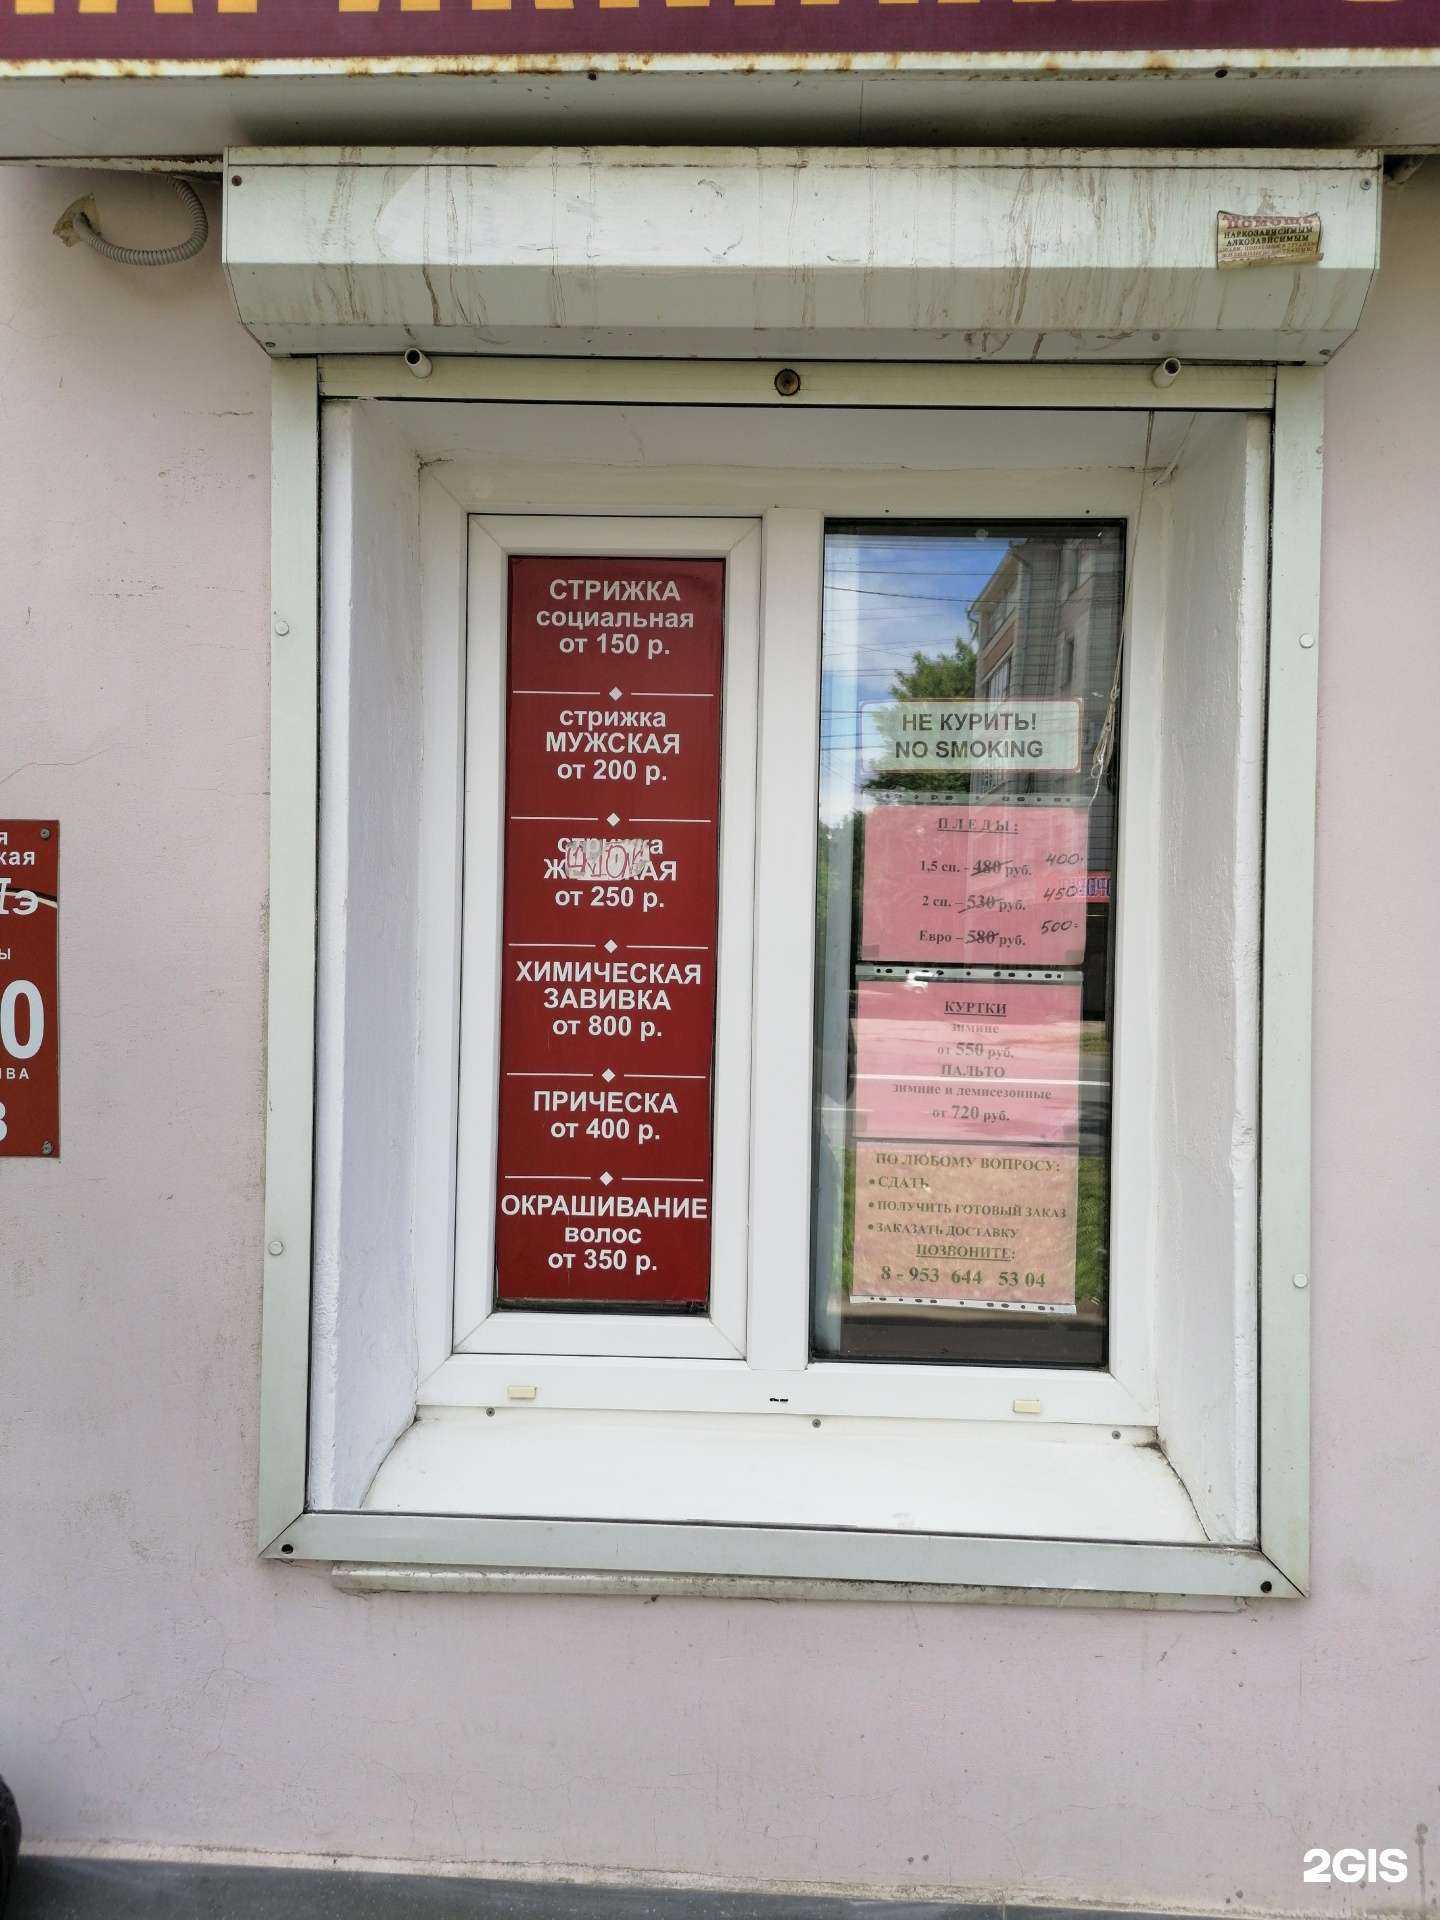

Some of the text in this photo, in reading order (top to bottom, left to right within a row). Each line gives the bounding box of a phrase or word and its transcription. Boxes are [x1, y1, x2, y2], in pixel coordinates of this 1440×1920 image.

[549, 578, 681, 601] СТРИЖКА
[536, 610, 694, 630] социальная
[559, 633, 670, 659] от 150 р.
[559, 709, 666, 731] стрижка
[902, 712, 1037, 732] НЕ КУРИТЬ!
[546, 731, 680, 755] МУЖСКАЯ
[895, 740, 1044, 759] NO SMOKING
[557, 759, 667, 785] от 200 р.
[1005, 863, 1032, 878] руб.
[555, 886, 665, 912] от 250 р.
[922, 896, 929, 906] 2
[999, 900, 1026, 912] руб.
[919, 929, 952, 946] Евро
[999, 934, 1026, 947] руб.
[515, 961, 701, 985] ХИМИЧЕСКАЯ
[543, 988, 672, 1011] ЗАВИВКА
[944, 1001, 1008, 1016] КУРТКИ
[552, 1015, 662, 1041] от 800 р.
[937, 1042, 1014, 1059] от 550 руб.
[941, 1064, 1005, 1078] ПАЛЬТО
[533, 1090, 679, 1114] ПРИЧЕСКА
[892, 1084, 1052, 1100] зимние и демисезонные
[932, 1105, 1010, 1123] от 720 руб.
[550, 1118, 660, 1144] от 400 р.
[876, 1153, 1060, 1172] ПО ЛЮБОМУ ВОПРОСУ:
[878, 1176, 929, 1189] СДАТЬ
[501, 1194, 708, 1219] ОКРАШИВАНИЕ
[877, 1201, 1066, 1218] ПОЛУЧИТЬ ГОТОВЫЙ ЗАКАЗ
[564, 1226, 642, 1244] волос
[875, 1223, 1019, 1239] ЗАКАЗАТЬ ДОСТАВКУ
[548, 1249, 657, 1275] от 350 р.
[916, 1244, 1016, 1261] ПОЗВОНИТЕ:
[881, 1266, 891, 1280] 8
[909, 1267, 940, 1282] 953
[951, 1269, 983, 1285] 644
[998, 1271, 1019, 1287] 53
[1025, 1272, 1046, 1288] 04
